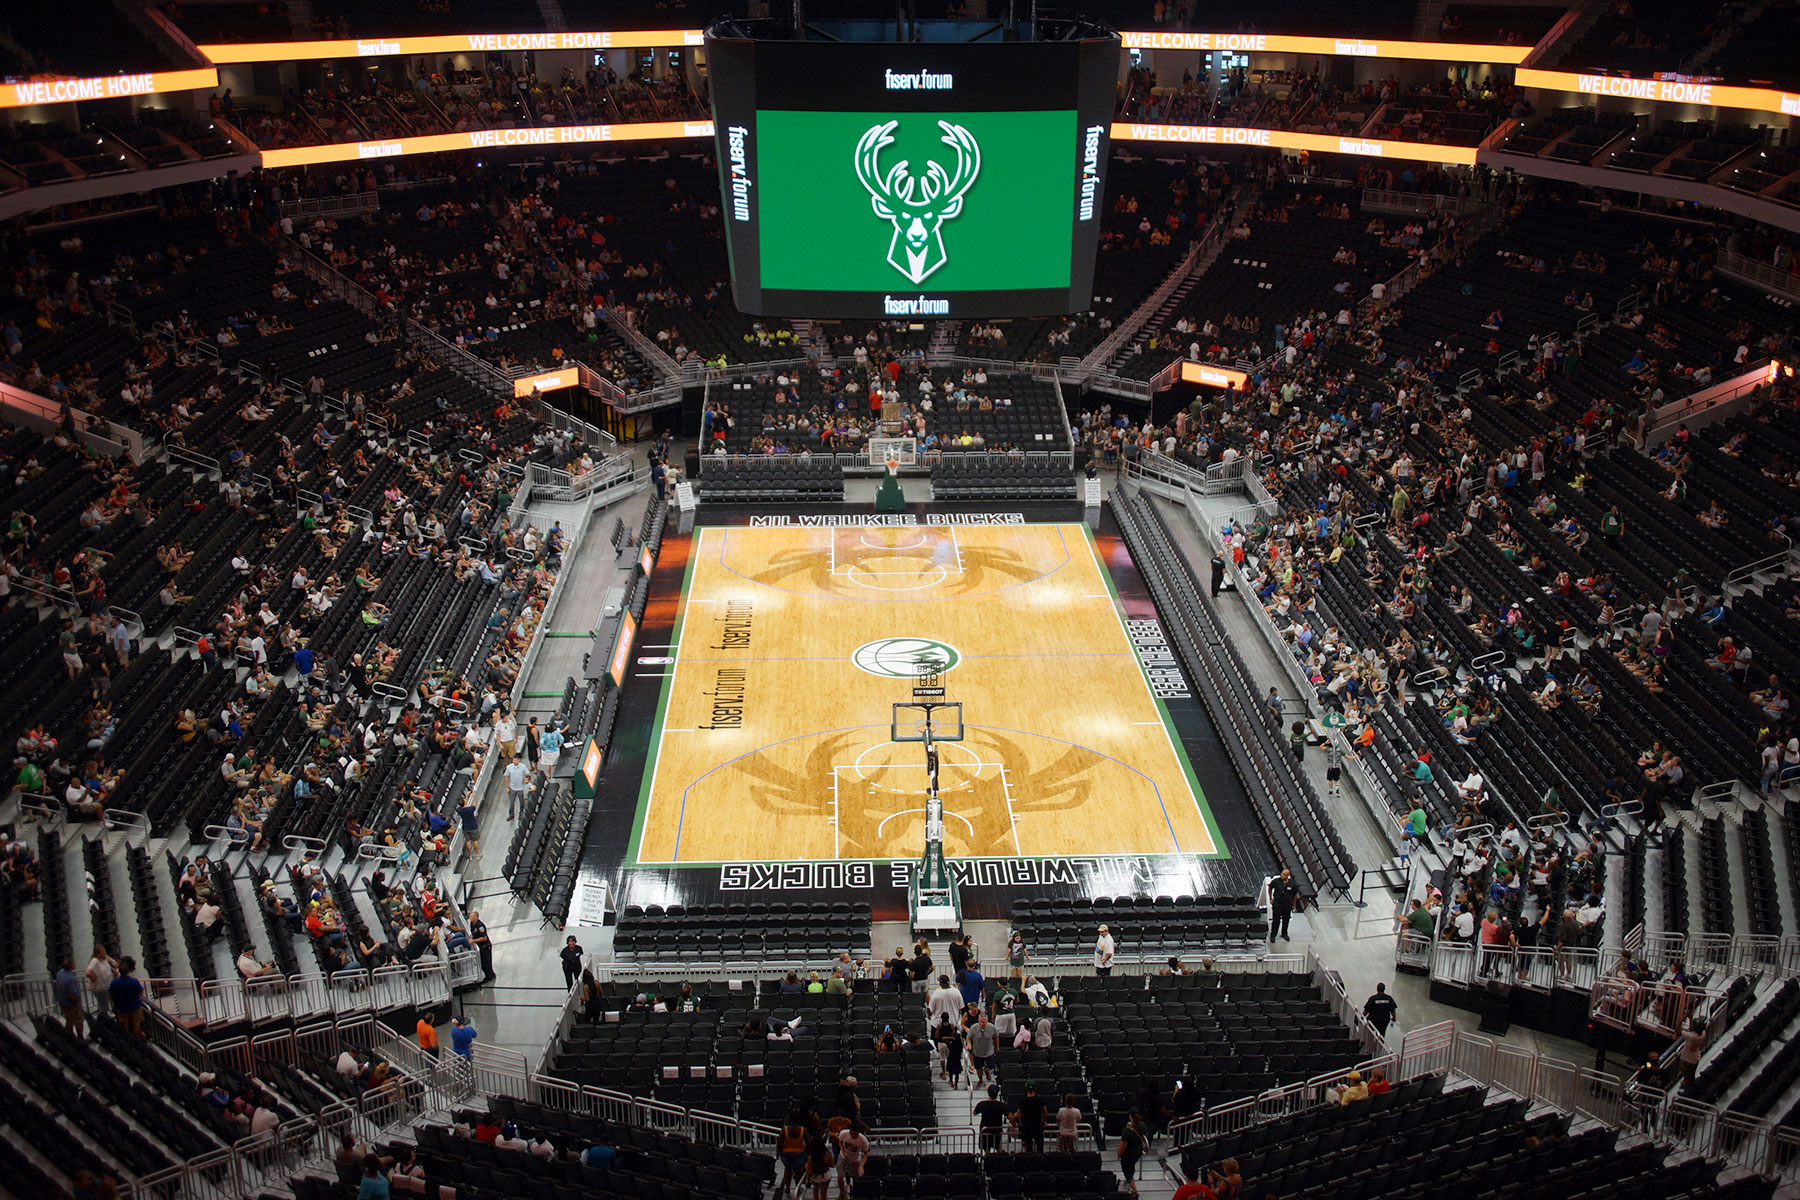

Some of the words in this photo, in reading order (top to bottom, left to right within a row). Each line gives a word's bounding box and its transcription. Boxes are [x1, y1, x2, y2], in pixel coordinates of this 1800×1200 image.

[468, 33, 556, 50] WELCOME
[562, 32, 612, 48] HOME
[1124, 32, 1210, 49] WELCOME
[1215, 34, 1267, 50] HOME
[16, 78, 104, 104] WELCOME
[108, 74, 155, 96] HOME
[885, 68, 953, 90] fiserv.forum
[1578, 74, 1658, 99] WELCOME
[1661, 81, 1713, 104] HOME
[470, 127, 556, 147] WELCOME
[561, 125, 612, 142] HOME
[1130, 124, 1216, 142] WELCOME
[1222, 128, 1271, 146] HOME
[728, 126, 752, 221] fiserv.forum
[1080, 125, 1104, 221] fiserv.forum
[884, 294, 949, 315] fiserv.forum
[750, 514, 917, 527] MILWAUKEE
[926, 513, 1026, 525] BUCKS
[1124, 619, 1167, 645] DEER
[1136, 646, 1177, 668] THE
[1145, 668, 1192, 698] FEAR
[719, 861, 874, 890] BUCKS
[892, 856, 1156, 889] MILWAUKE
